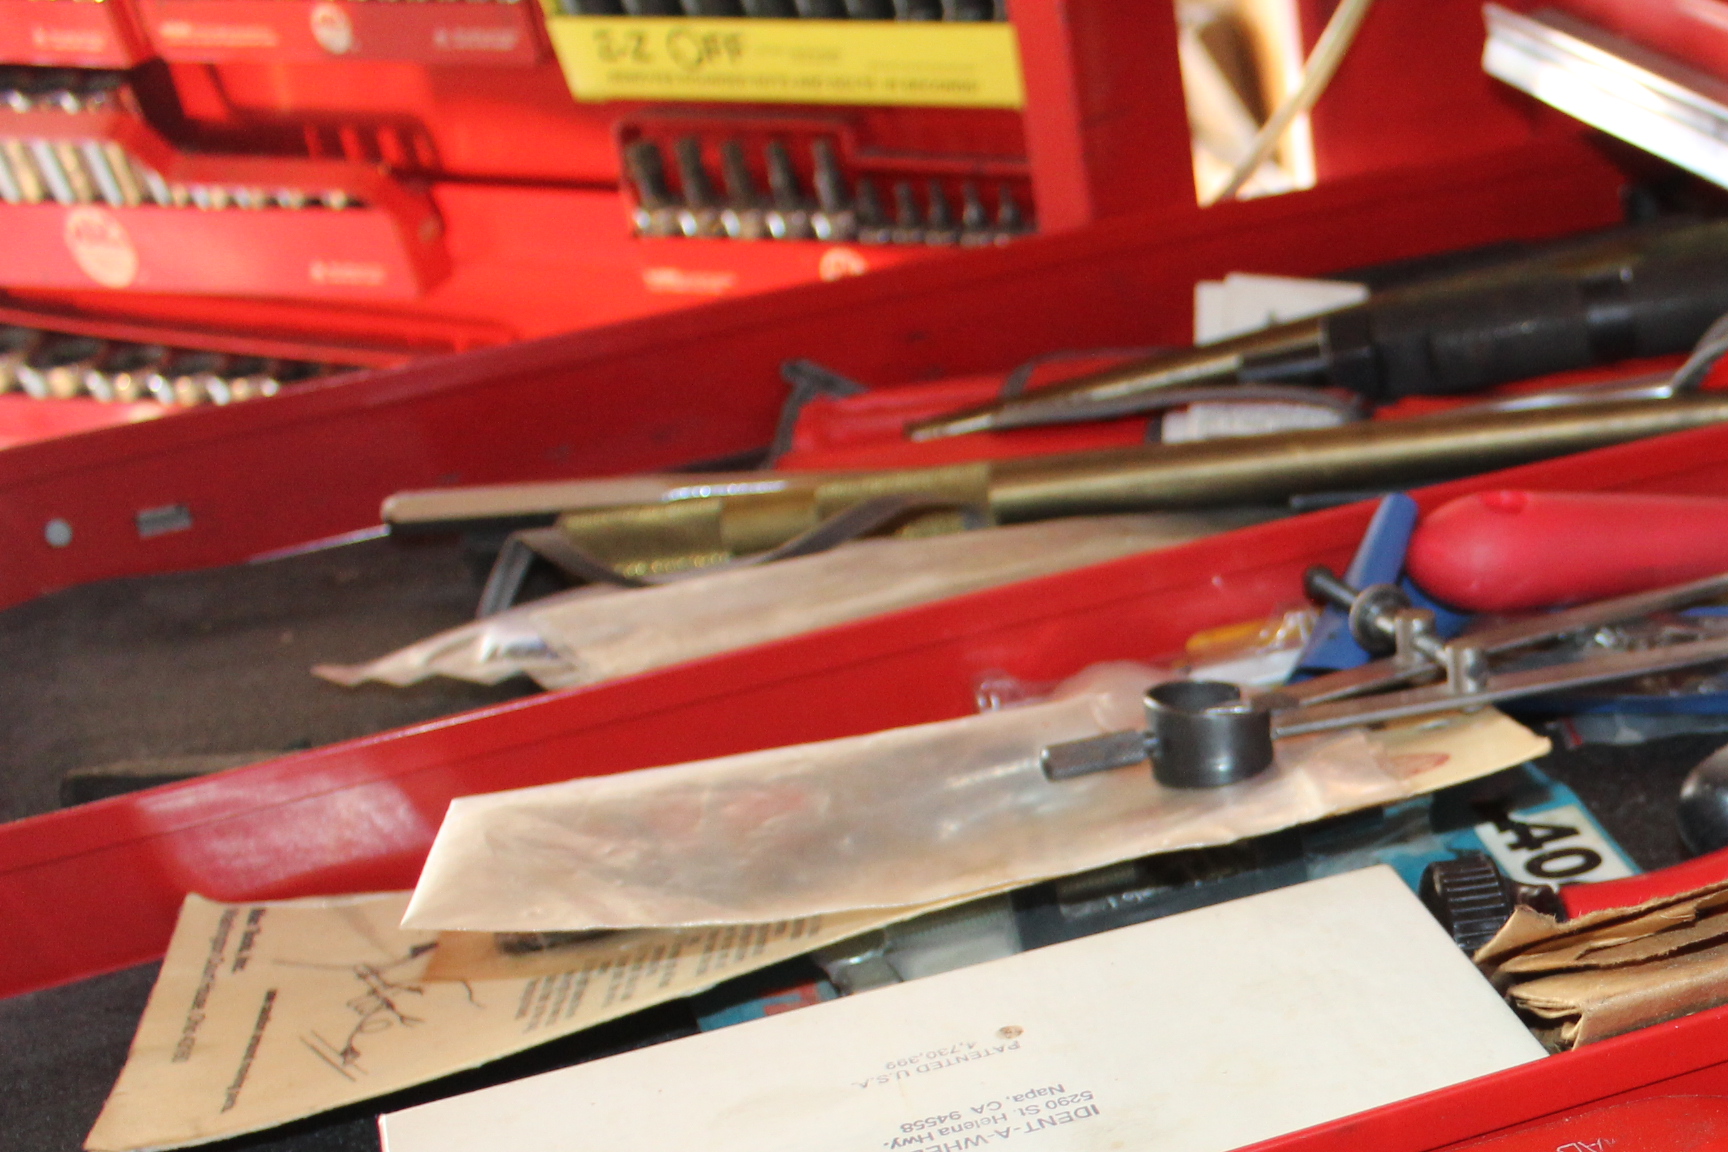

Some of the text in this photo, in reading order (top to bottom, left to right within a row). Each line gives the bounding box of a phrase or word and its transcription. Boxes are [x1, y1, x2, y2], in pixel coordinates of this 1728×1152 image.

[915, 1040, 1021, 1074] PATENTED
[883, 1089, 1094, 1151] 5290 St. Helena Hwy.
[899, 1083, 1066, 1134] Napa, CA 94558
